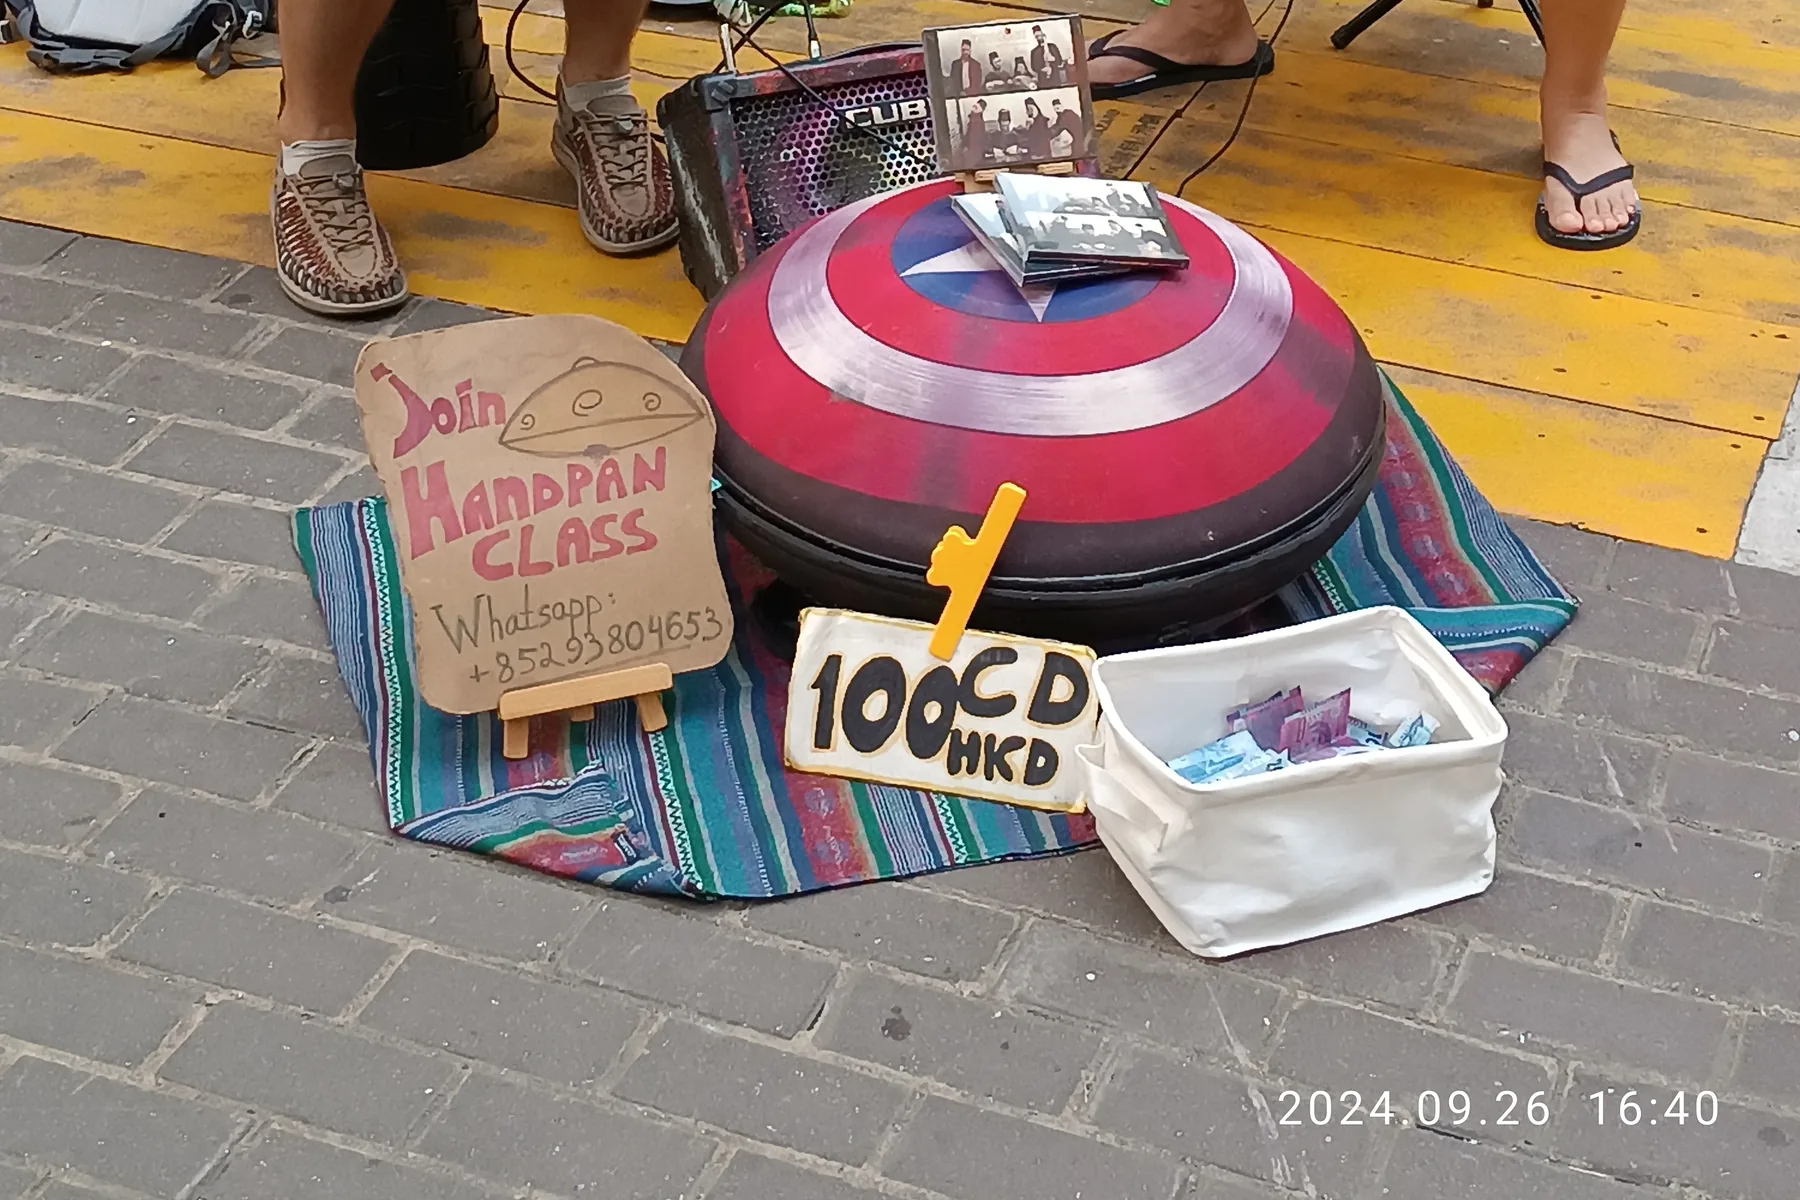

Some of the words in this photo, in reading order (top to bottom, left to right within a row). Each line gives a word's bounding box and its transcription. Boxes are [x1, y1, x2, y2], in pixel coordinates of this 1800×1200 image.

[845, 98, 931, 129] CUB
[370, 362, 507, 459] Join
[472, 508, 659, 581] CLASS
[811, 654, 958, 759] 100
[957, 646, 1090, 725] CD
[947, 728, 1060, 786] HKD
